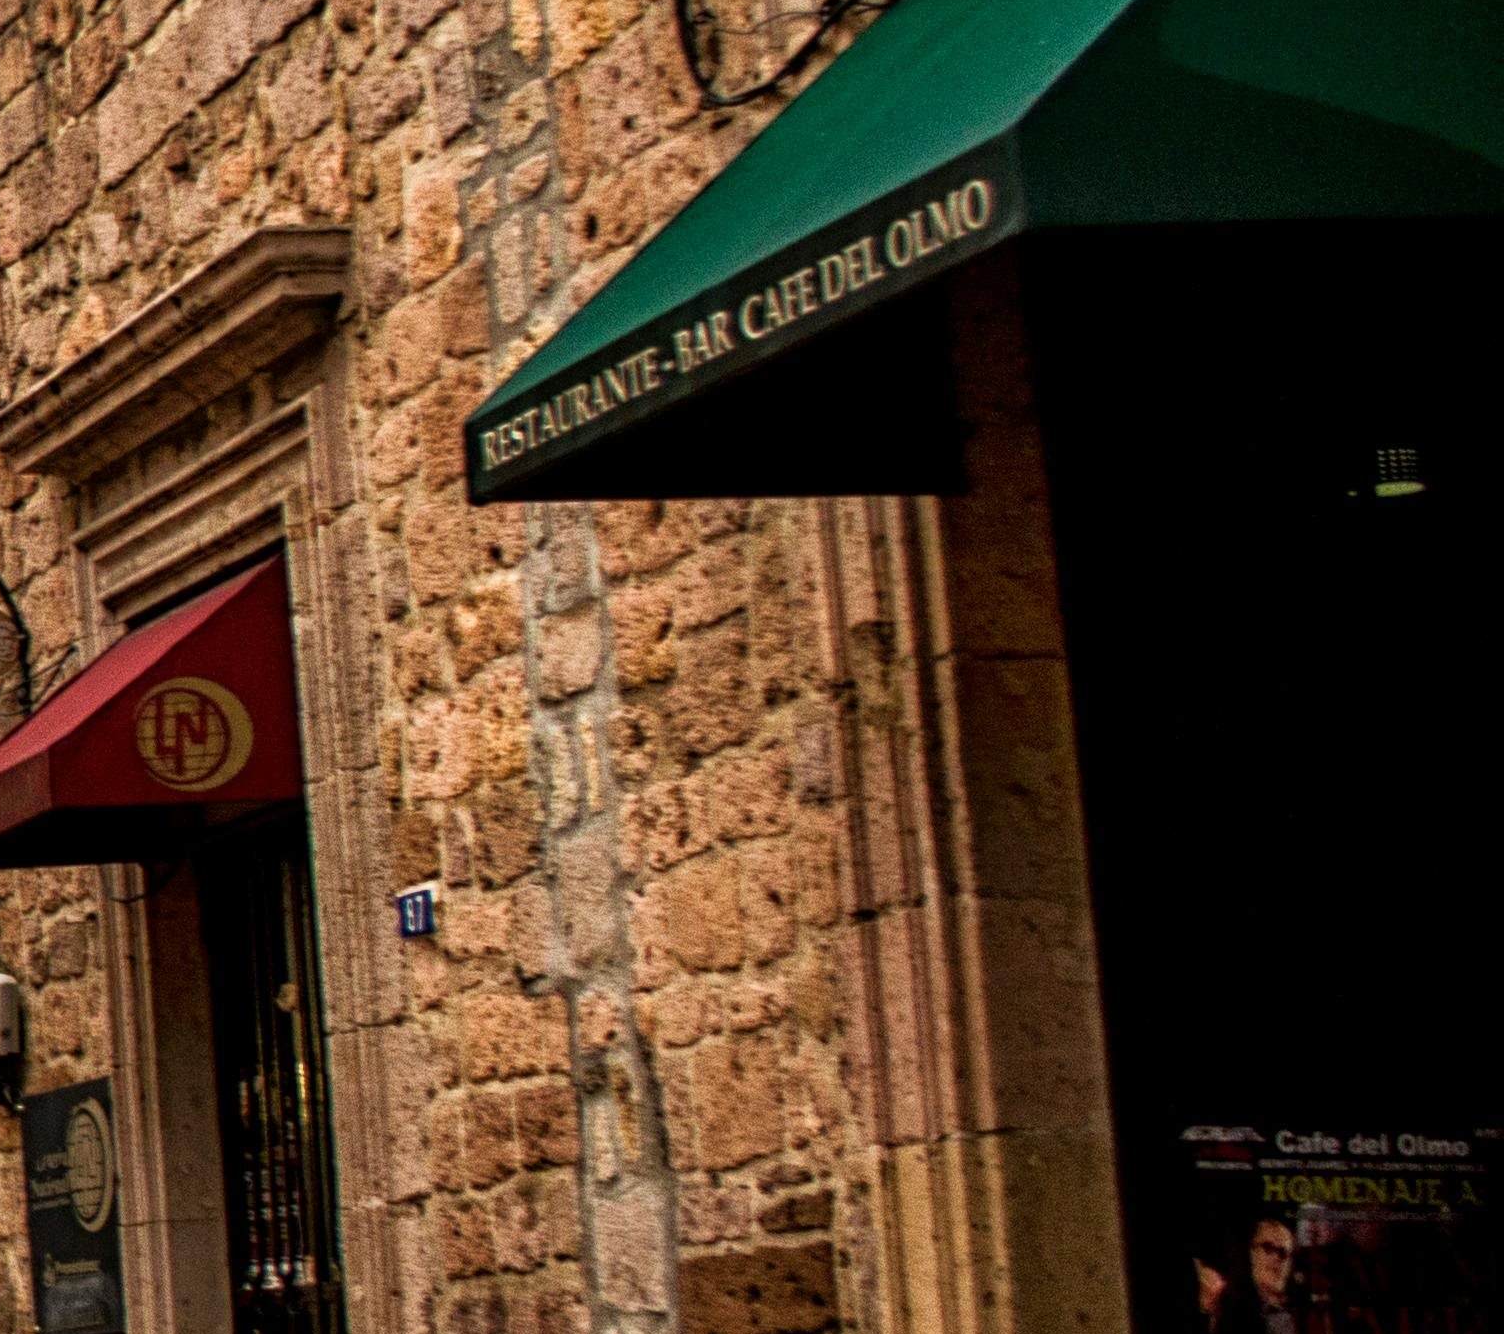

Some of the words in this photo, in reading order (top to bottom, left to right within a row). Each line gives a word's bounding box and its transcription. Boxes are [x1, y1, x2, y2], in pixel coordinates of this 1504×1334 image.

[738, 267, 821, 341] CAFE
[818, 235, 888, 304] DEL
[886, 178, 995, 268] OLMO
[1273, 1128, 1342, 1156] Cafe
[1346, 1131, 1391, 1156] del
[1395, 1132, 1472, 1158] Olmo
[1261, 1173, 1443, 1205] HOMENAJE
